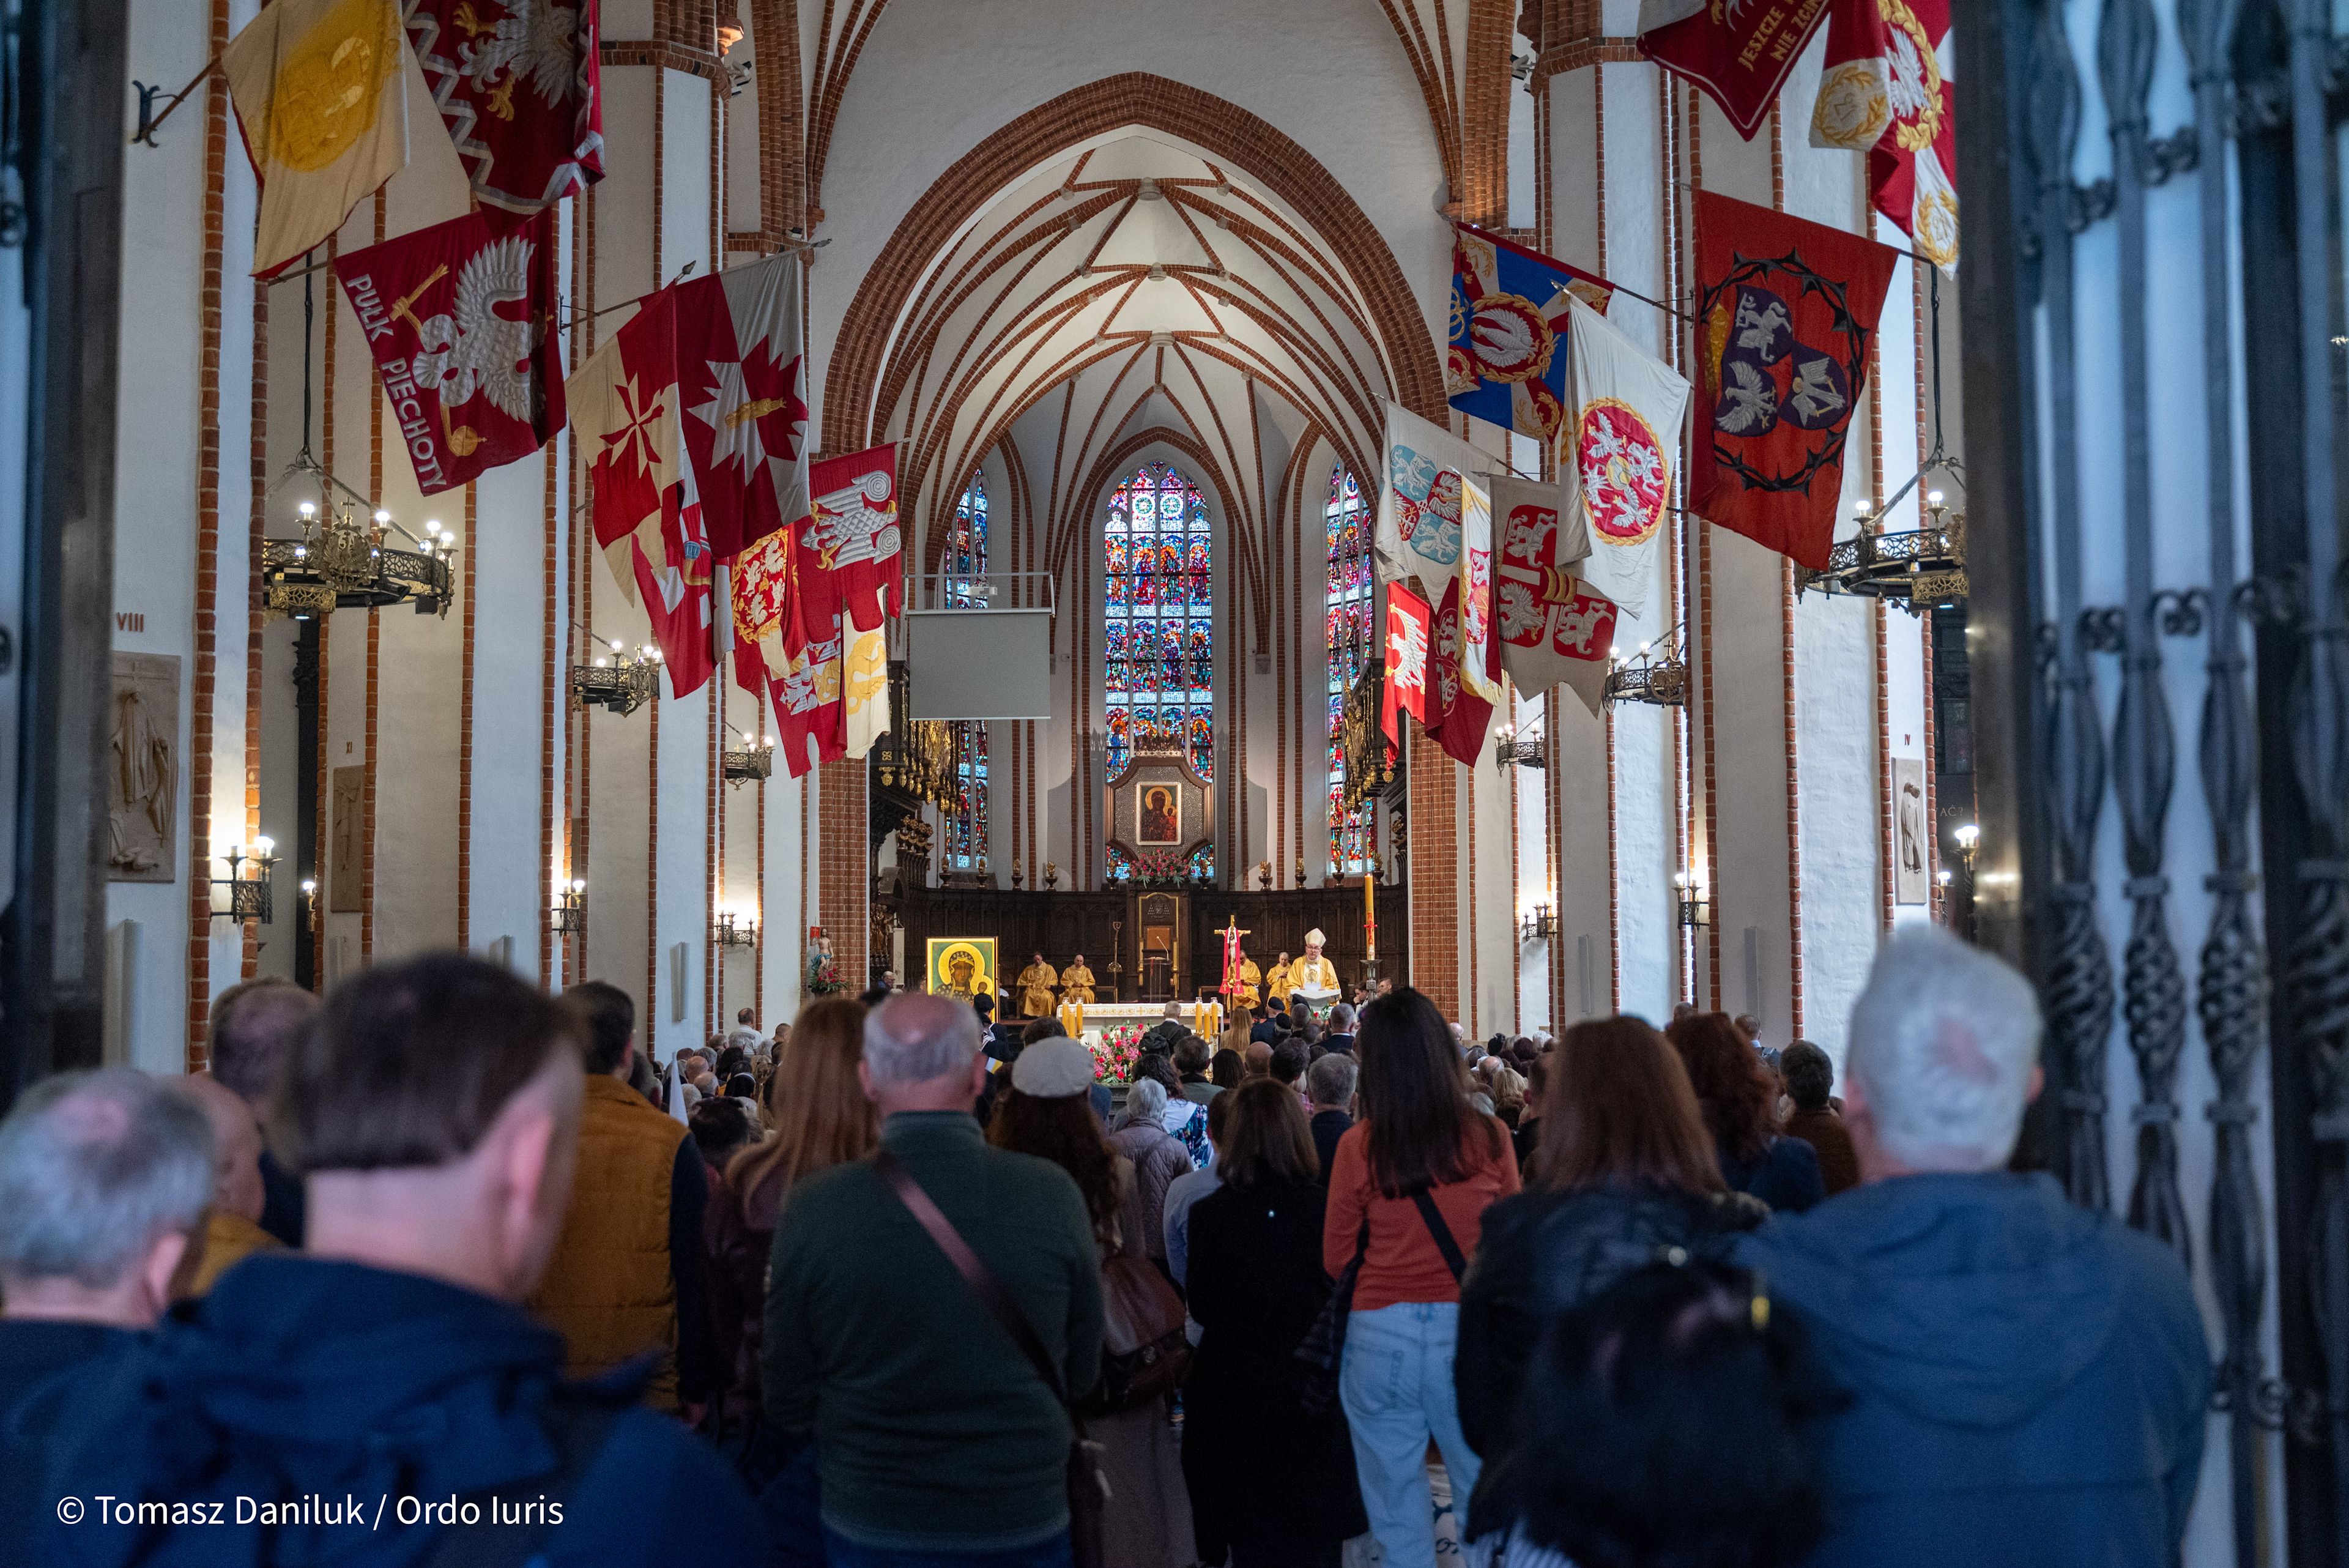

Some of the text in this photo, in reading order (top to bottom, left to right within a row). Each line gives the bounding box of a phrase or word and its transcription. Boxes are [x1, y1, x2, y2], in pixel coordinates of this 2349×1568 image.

[1738, 6, 1785, 73] JESZCZE
[1770, 30, 1797, 62] NIE
[346, 273, 447, 487] PUŁK PIECHOTY
[116, 611, 144, 633] VIII
